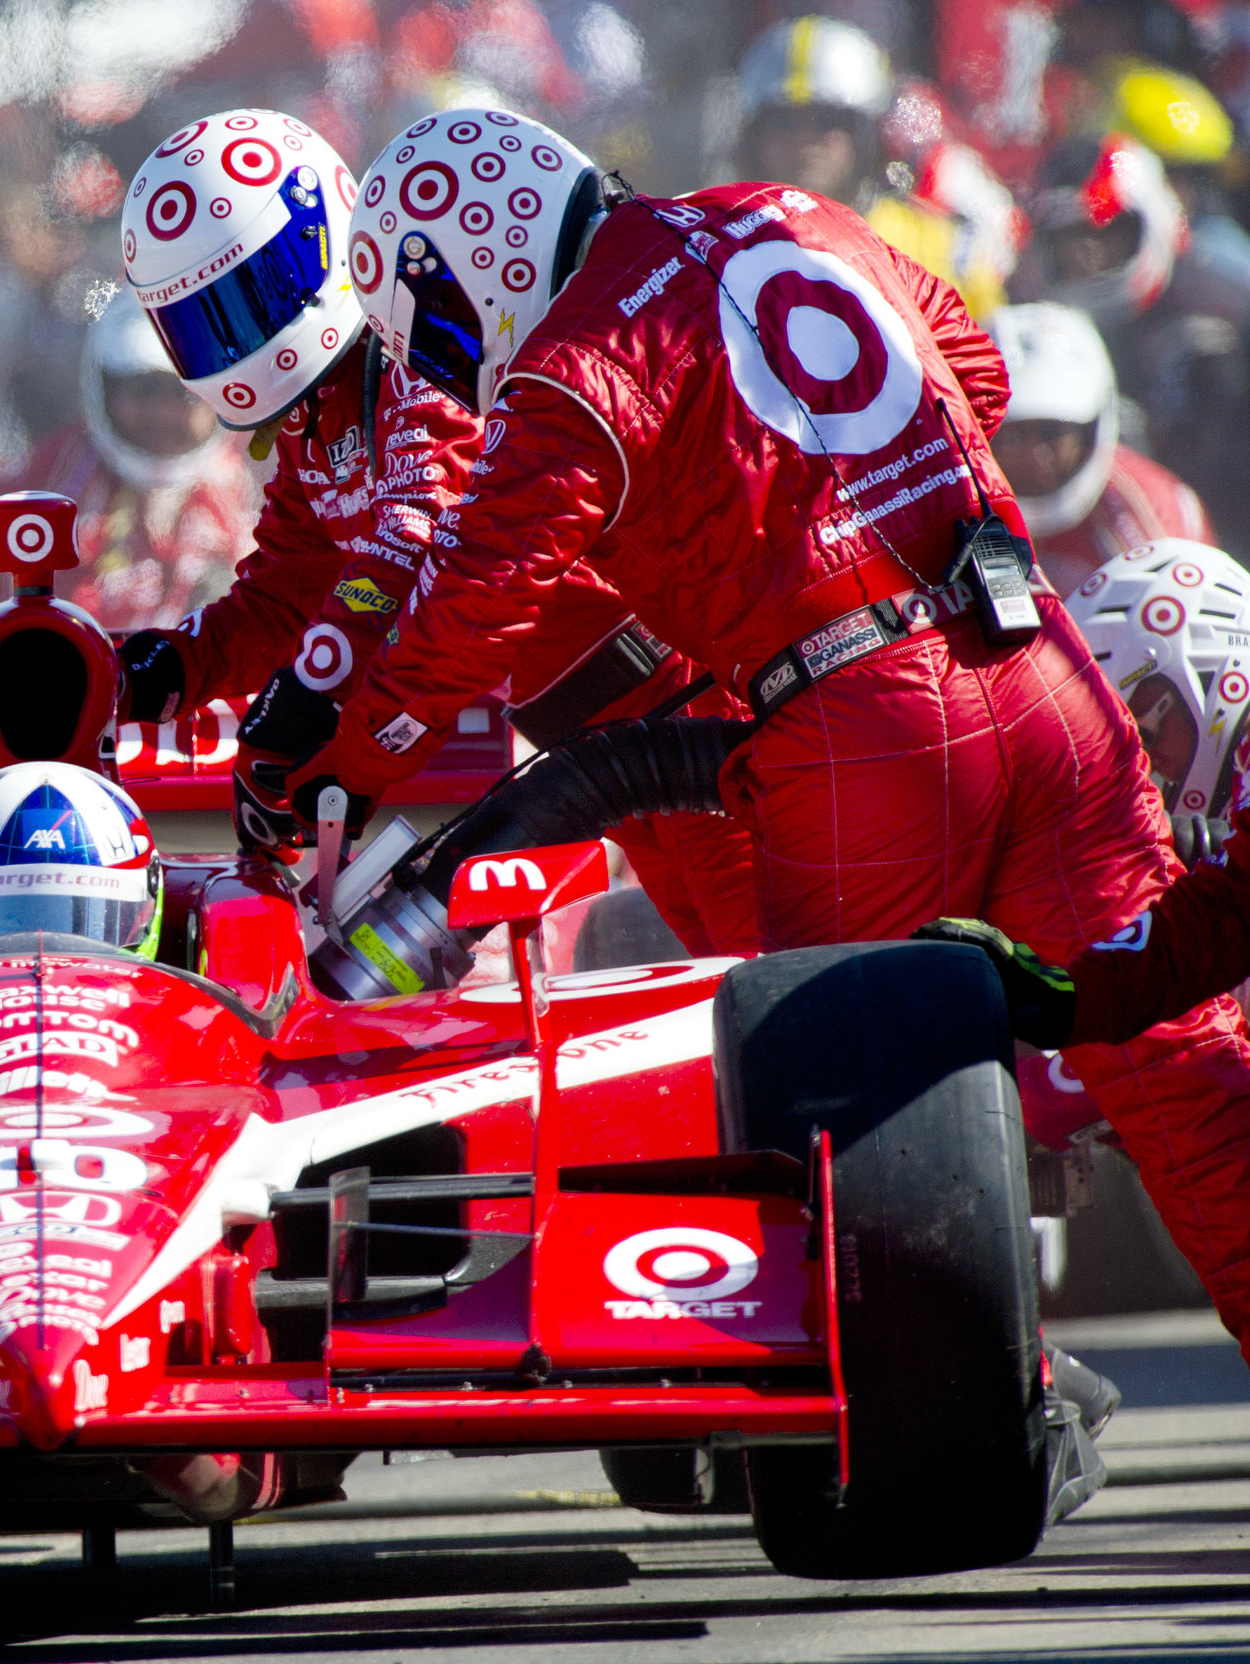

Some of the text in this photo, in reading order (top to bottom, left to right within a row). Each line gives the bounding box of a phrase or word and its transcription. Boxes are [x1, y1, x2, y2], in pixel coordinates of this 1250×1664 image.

[137, 242, 244, 303] target.com
[618, 257, 681, 318] Energizer
[385, 424, 429, 450] reveal
[386, 465, 436, 490] PHOTO
[836, 437, 949, 503] www.target.com
[382, 504, 432, 519] SHERWIN
[335, 581, 395, 612] SUNOCO
[812, 612, 870, 649] TARGET
[819, 626, 877, 662] GANASSI
[812, 637, 881, 676] RACING
[23, 829, 66, 849] AXA
[398, 1029, 649, 1109] Firesone
[603, 1300, 764, 1320] TARGET
